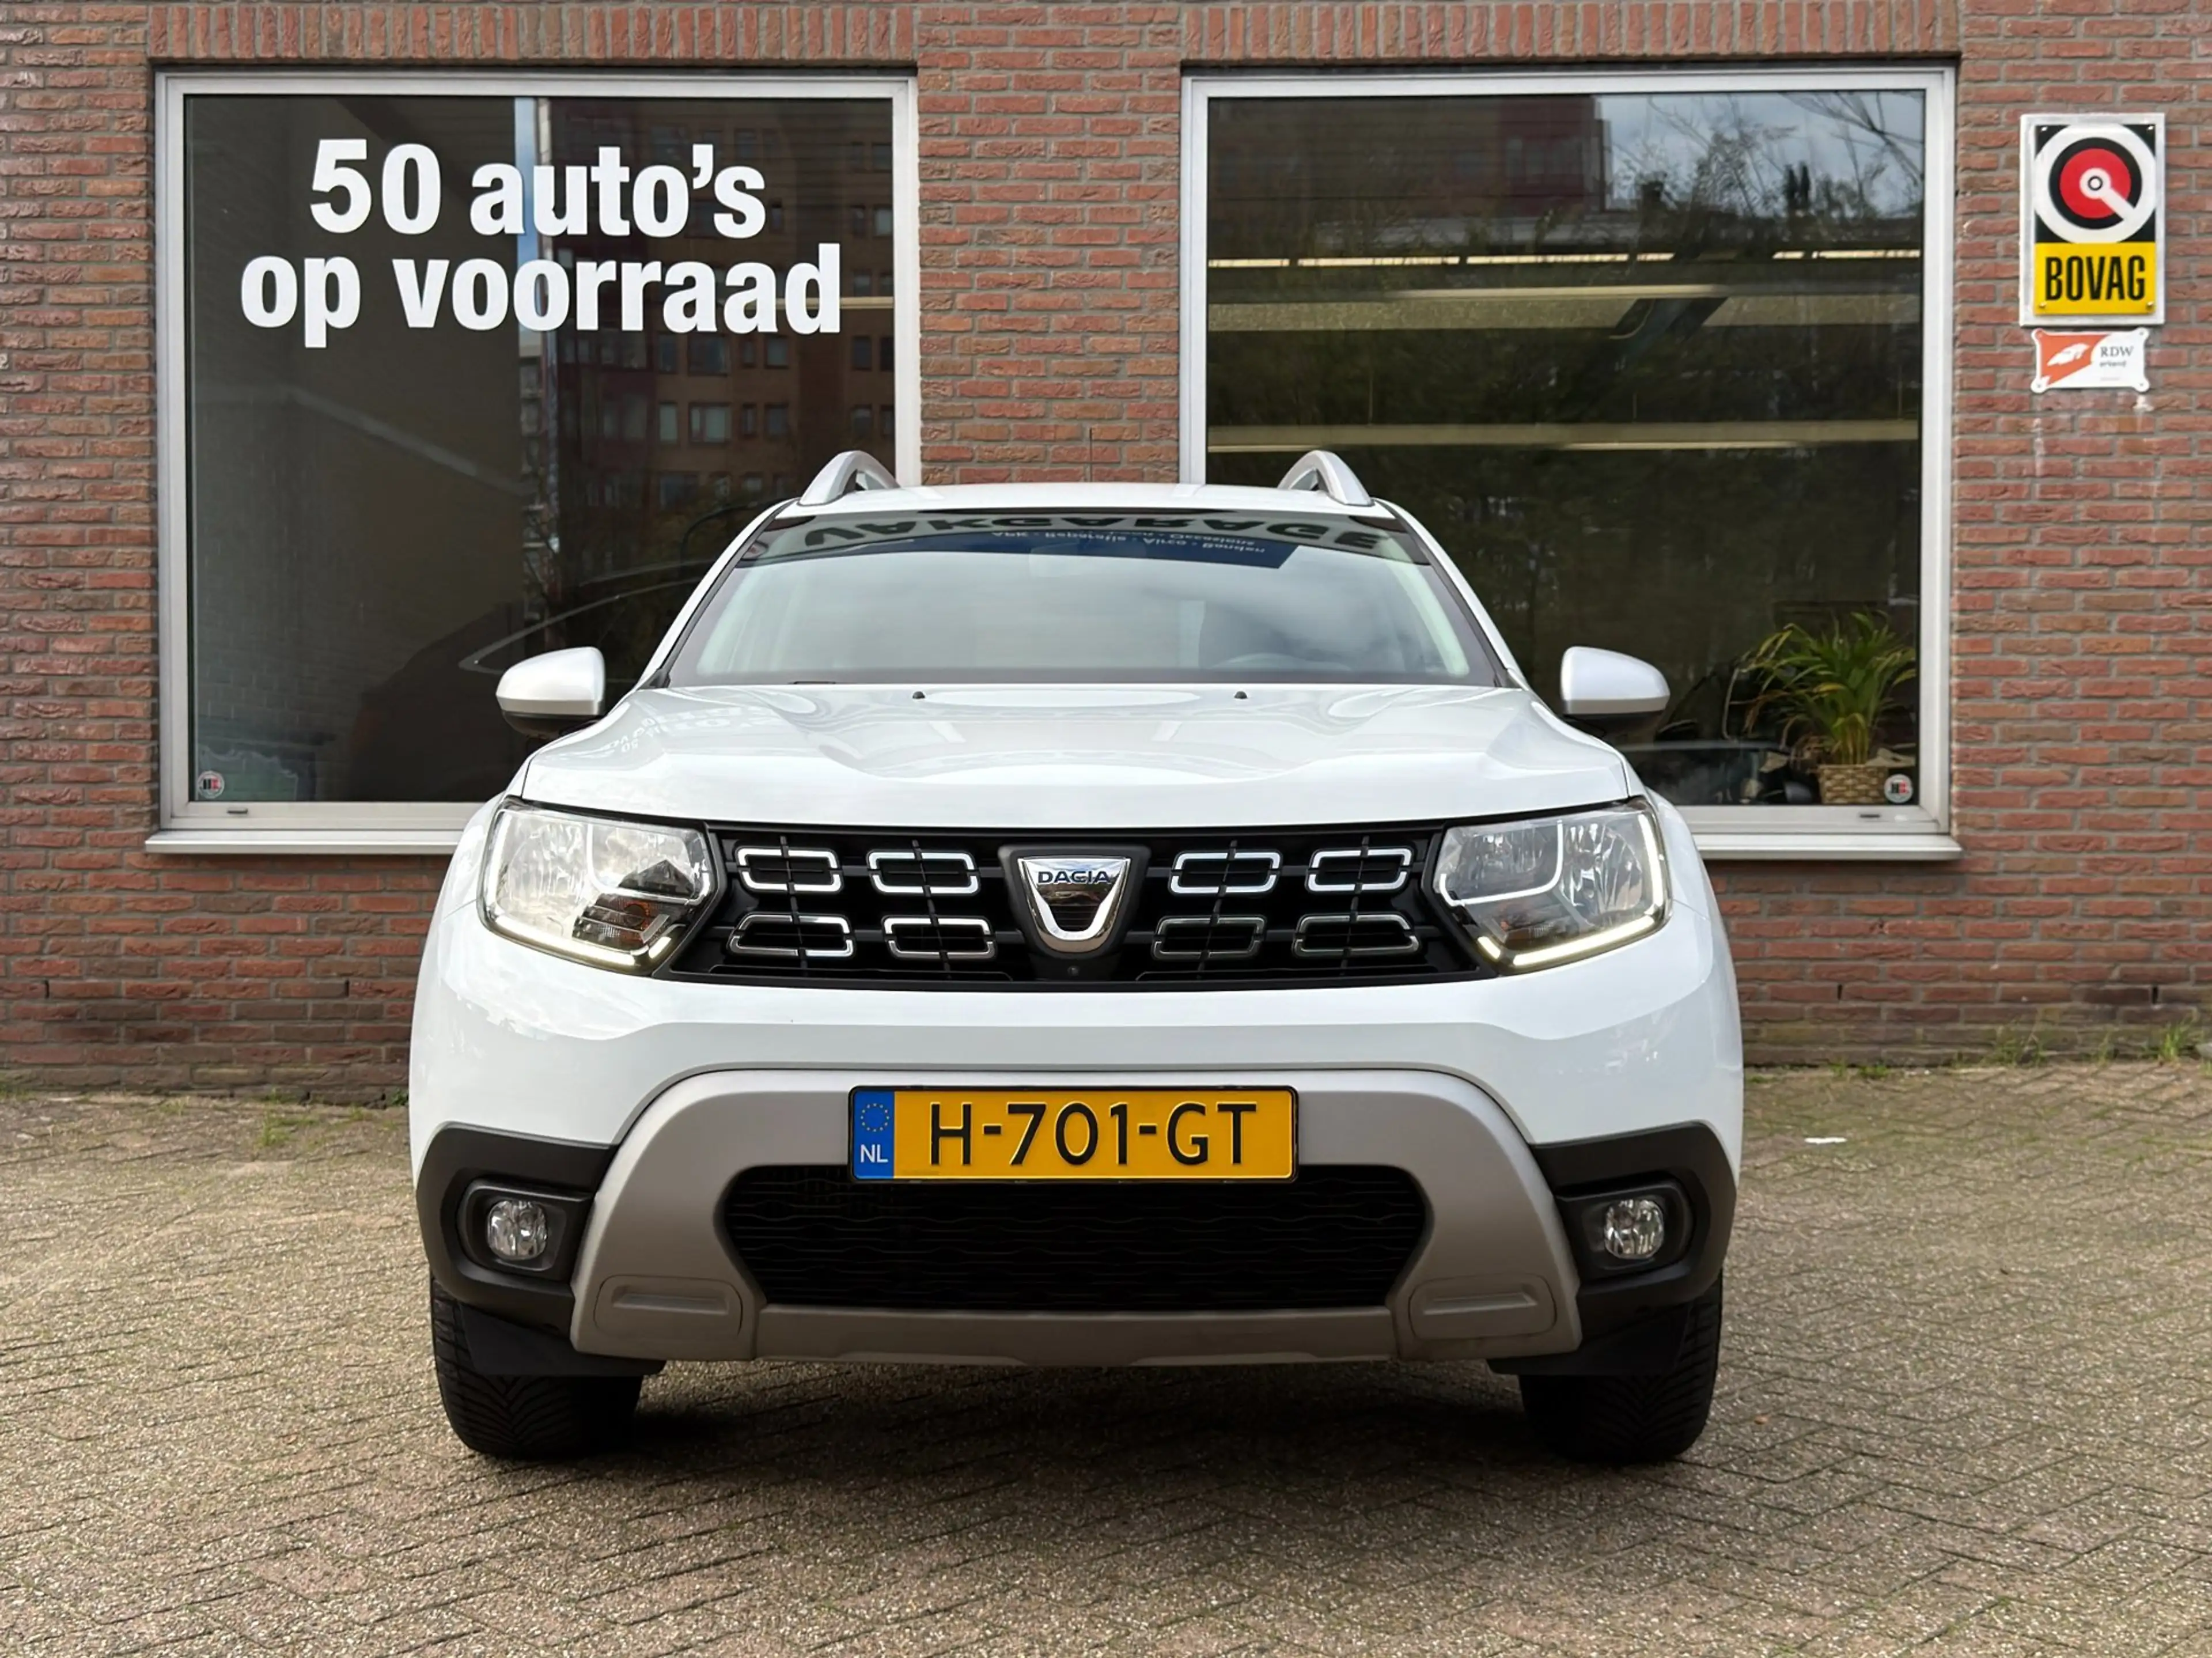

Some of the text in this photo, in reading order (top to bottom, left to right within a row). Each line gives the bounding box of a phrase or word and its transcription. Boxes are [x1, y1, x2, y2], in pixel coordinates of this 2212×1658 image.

[310, 138, 766, 239] 50 auto's
[240, 243, 840, 349] op voorraad
[2045, 255, 2146, 302] BOVAG
[2100, 346, 2134, 357] RDW
[1037, 870, 1111, 883] DACIA
[860, 1144, 888, 1163] NL
[929, 1102, 1257, 1165] H-701-GT
